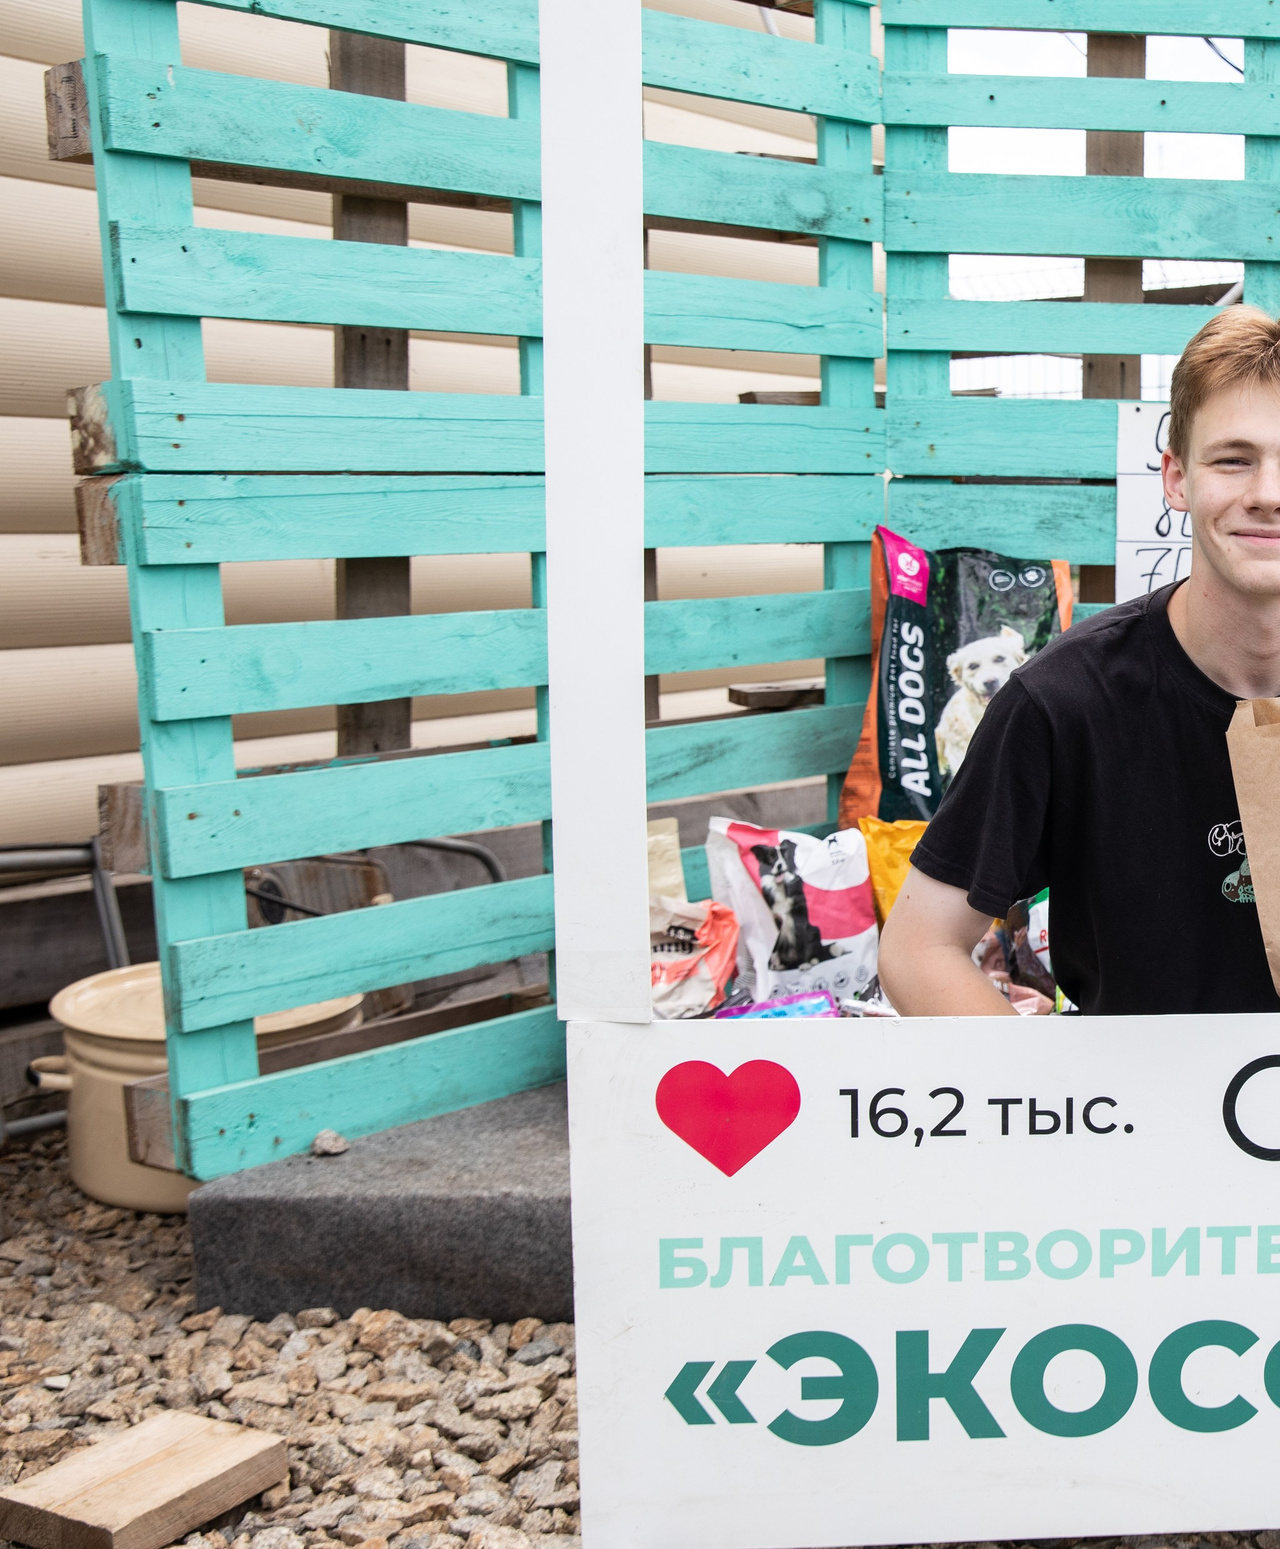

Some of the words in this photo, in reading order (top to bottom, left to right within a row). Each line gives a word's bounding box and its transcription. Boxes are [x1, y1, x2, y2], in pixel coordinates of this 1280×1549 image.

[889, 663, 897, 682] pet
[898, 621, 926, 726] DOGS
[887, 683, 898, 727] premium
[900, 732, 932, 797] ALL
[840, 1087, 966, 1150] 16,2
[988, 1097, 1134, 1136] тыс.
